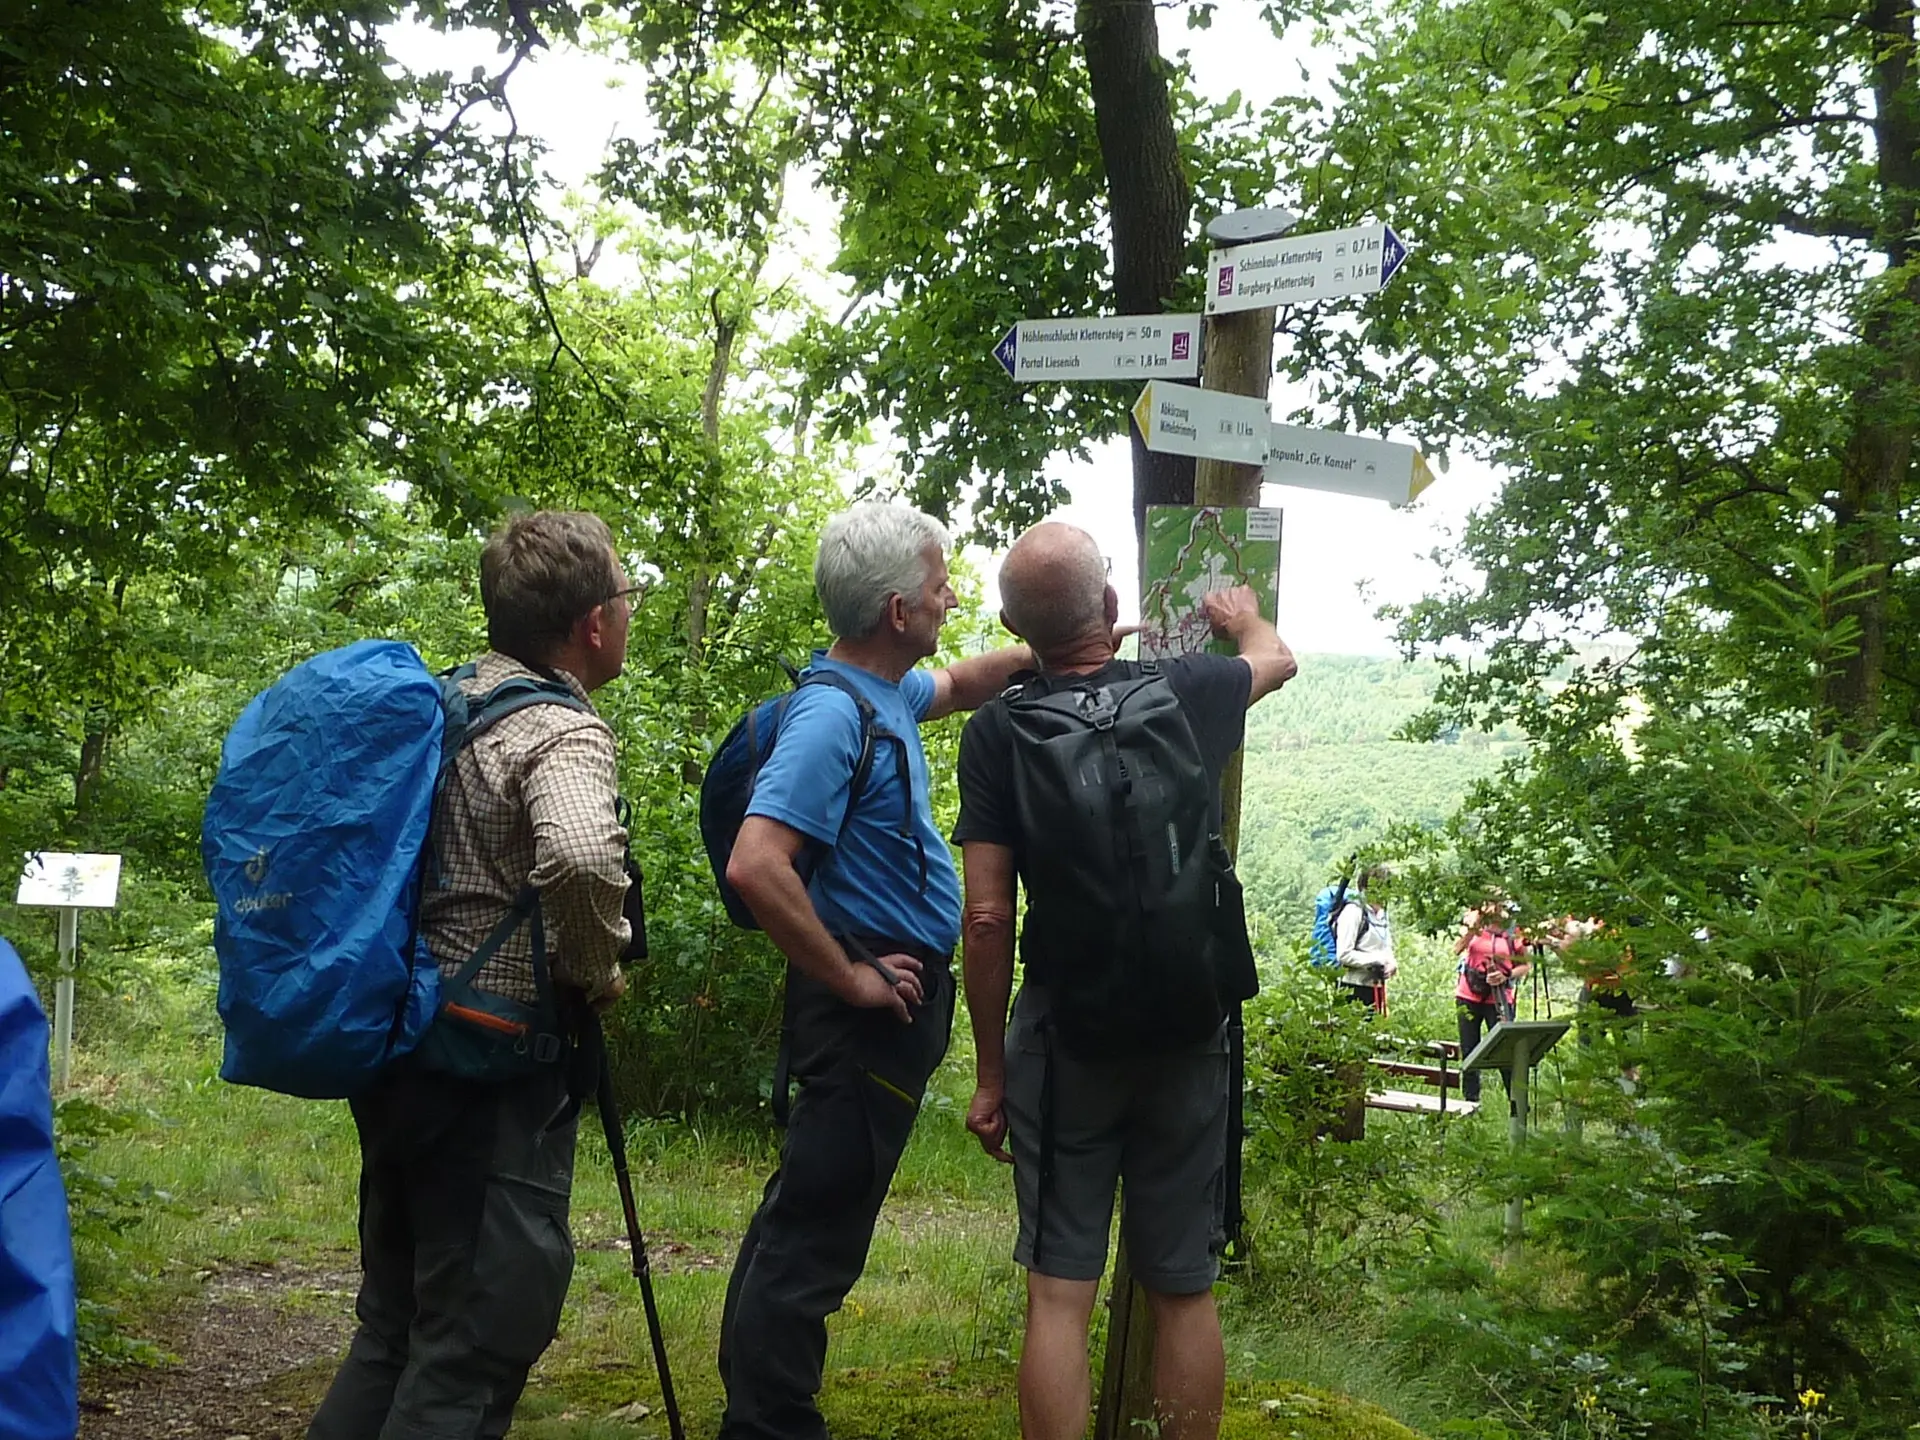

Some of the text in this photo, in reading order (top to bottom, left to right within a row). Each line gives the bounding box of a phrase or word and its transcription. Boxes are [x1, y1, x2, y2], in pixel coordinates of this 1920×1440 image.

[1352, 239, 1365, 254] 0,7
[1367, 237, 1380, 250] km
[1238, 262, 1378, 297] Burgberg-Klettersteig 1,6 km
[1022, 326, 1161, 342] Höhlenschlucht Klettersteig 50 m
[1021, 354, 1167, 369] Portal Liesenich 1,8 km
